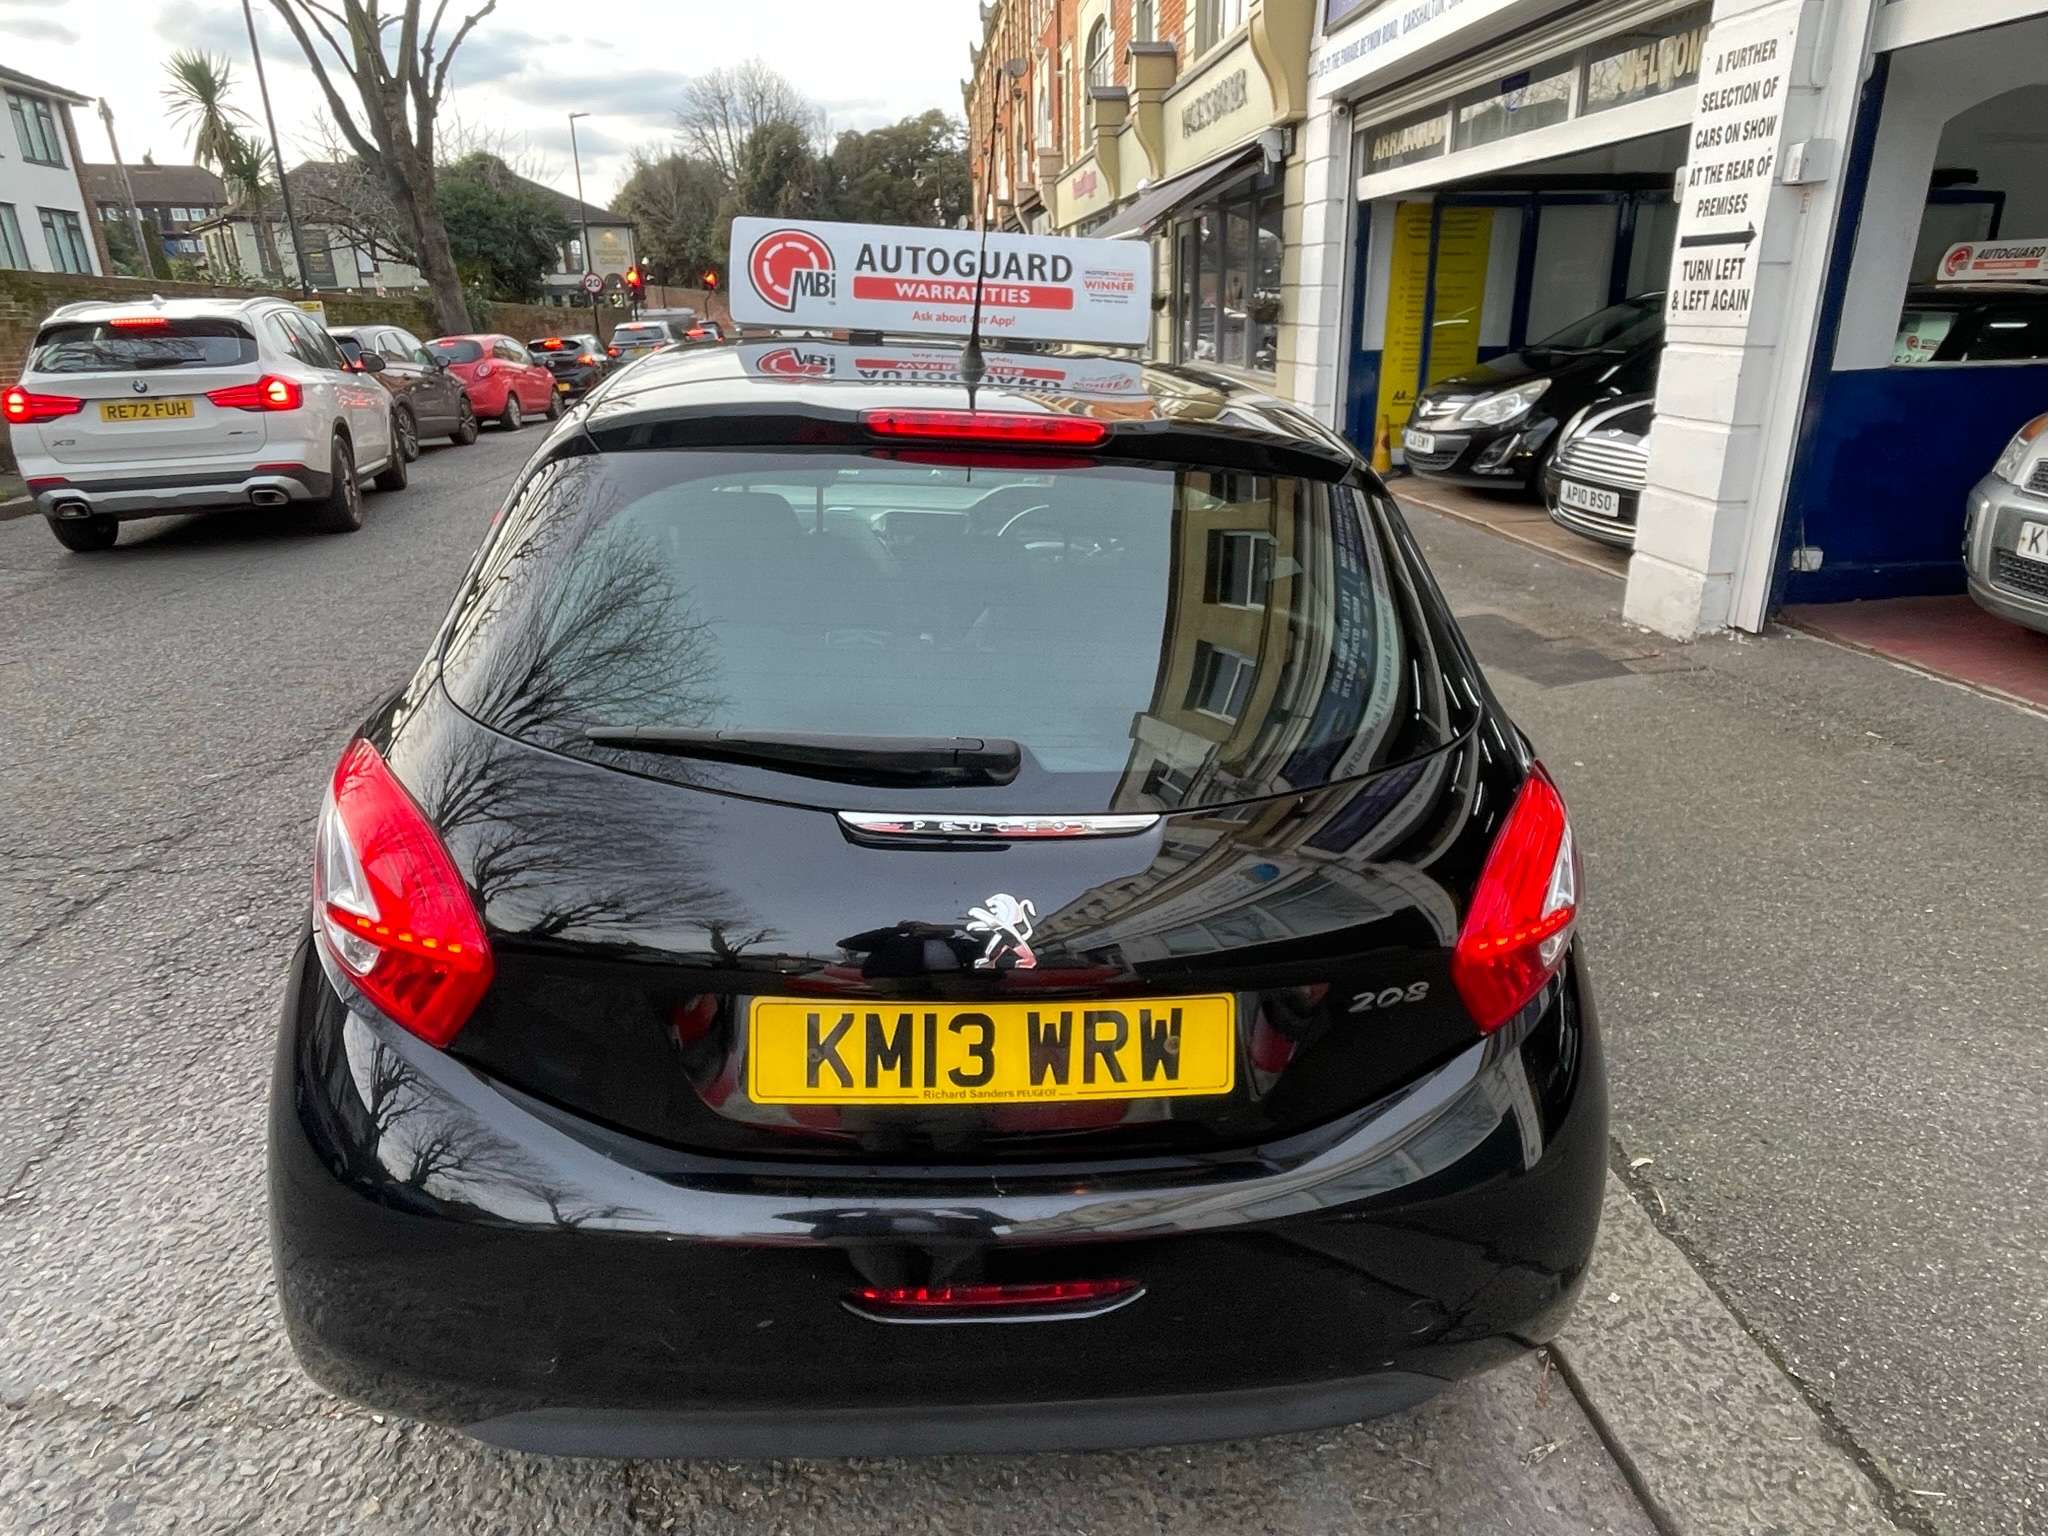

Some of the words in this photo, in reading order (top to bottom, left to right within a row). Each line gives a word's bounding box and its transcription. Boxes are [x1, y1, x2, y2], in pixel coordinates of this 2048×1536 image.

[1715, 54, 1722, 75] A
[1725, 38, 1778, 72] FURTHER
[1701, 79, 1761, 114] SELECTION
[1762, 76, 1779, 100] OF
[1695, 126, 1723, 150] CARS
[1725, 122, 1741, 144] ON
[1743, 115, 1778, 142] SHOW
[1688, 167, 1703, 187] AT
[1704, 162, 1725, 185] THE
[1725, 158, 1753, 182] REAR
[1757, 155, 1773, 177] OF
[1696, 193, 1749, 218] PREMISES
[854, 243, 1073, 282] AUTOGUARD
[1976, 246, 2046, 260] AUTOGUARD
[1683, 258, 1713, 282] TURN
[1715, 257, 1745, 280] LEFT
[586, 278, 600, 288] 20
[895, 281, 1031, 304] WARRANTIES
[1083, 280, 1135, 291] WINNER
[1671, 290, 1679, 311] &
[1682, 290, 1710, 311] LEFT
[1710, 289, 1750, 311] AGAIN
[911, 311, 932, 321] Ask
[935, 311, 967, 323] about
[989, 314, 1016, 327] App!
[106, 404, 151, 420] RE72
[155, 402, 188, 417] FUH
[1566, 481, 1588, 507] AP10
[1589, 491, 1612, 513] BSO
[2028, 527, 2048, 556] K
[1348, 981, 1430, 1013] 208
[806, 1012, 996, 1089] KM13
[1027, 1007, 1183, 1085] WRW
[923, 1090, 967, 1100] Richard
[969, 1089, 1015, 1099] Sanders
[1017, 1088, 1057, 1097] PEUGEOT
